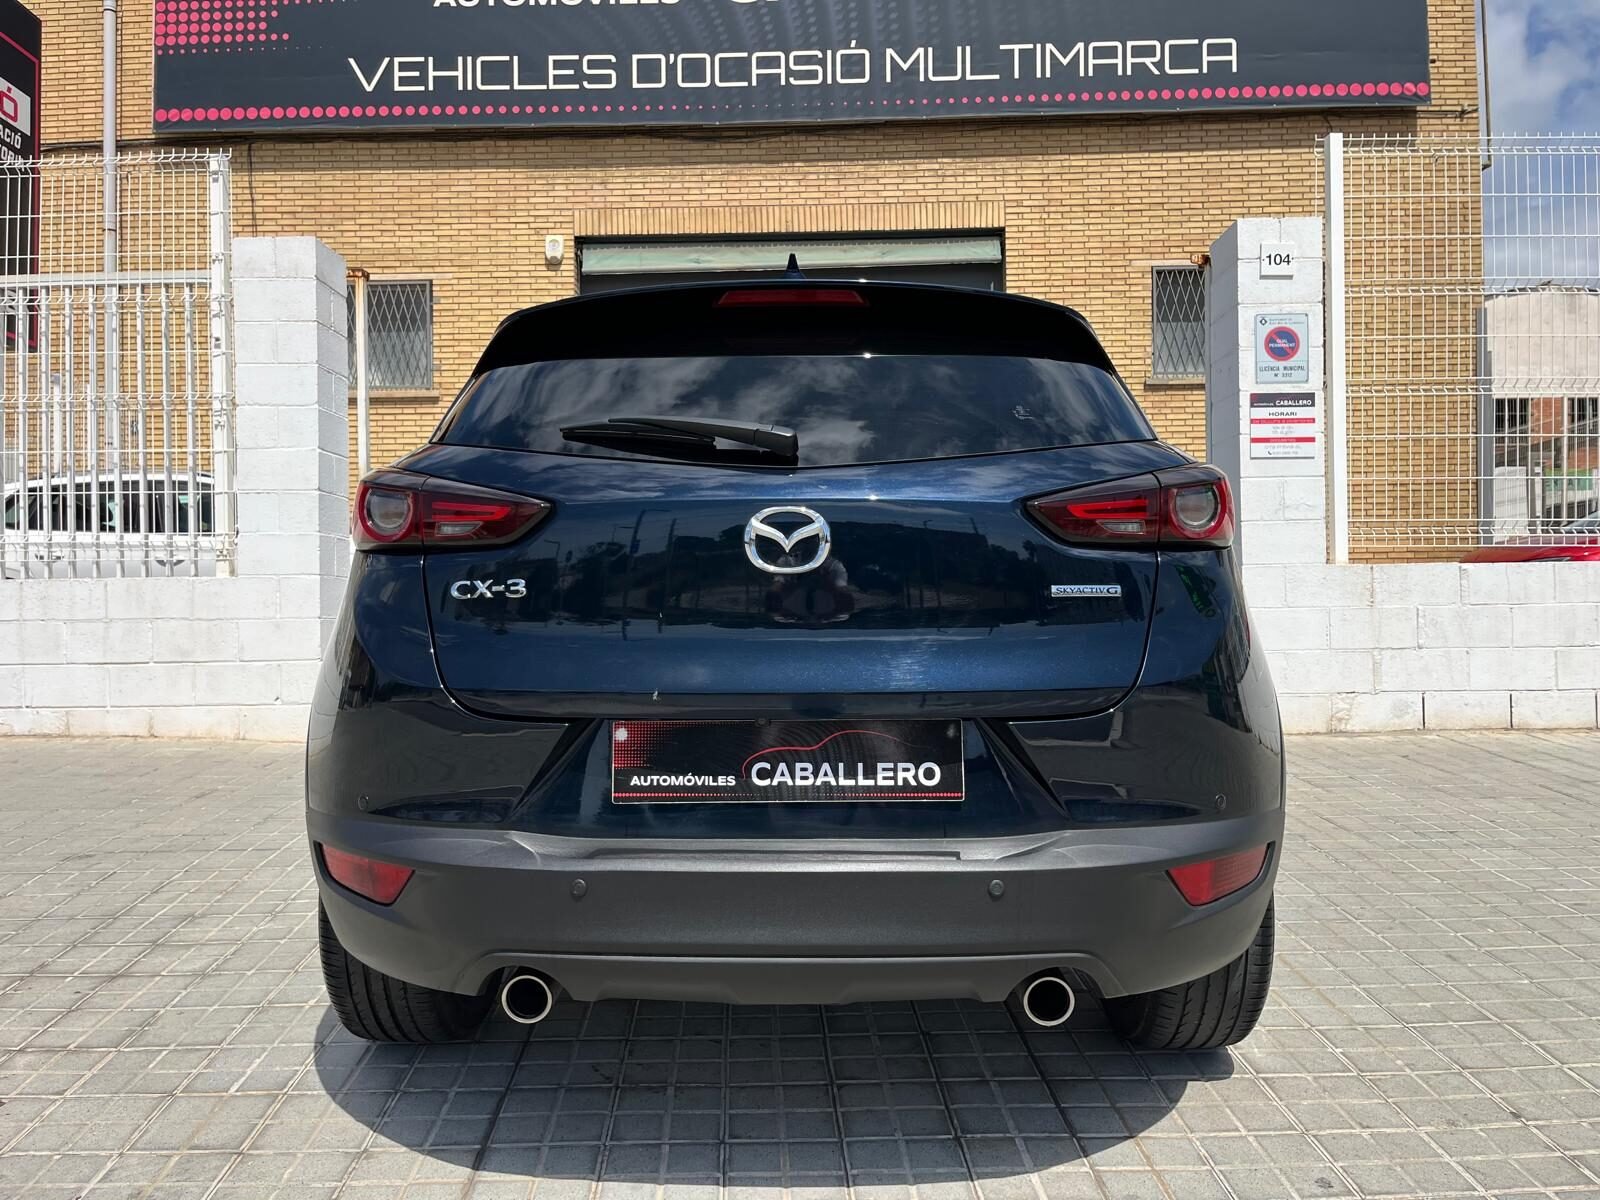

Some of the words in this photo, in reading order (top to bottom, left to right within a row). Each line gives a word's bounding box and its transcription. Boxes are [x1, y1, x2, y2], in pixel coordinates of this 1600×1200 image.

[347, 54, 617, 92] VEHICLES
[631, 39, 871, 89] D'OCASIÓ
[885, 37, 1238, 83] MULTIMARCA
[1265, 253, 1292, 266] 104
[450, 578, 527, 600] CX-3
[630, 772, 736, 787] AUTOMÓVILES
[751, 761, 941, 787] CABALLERO
